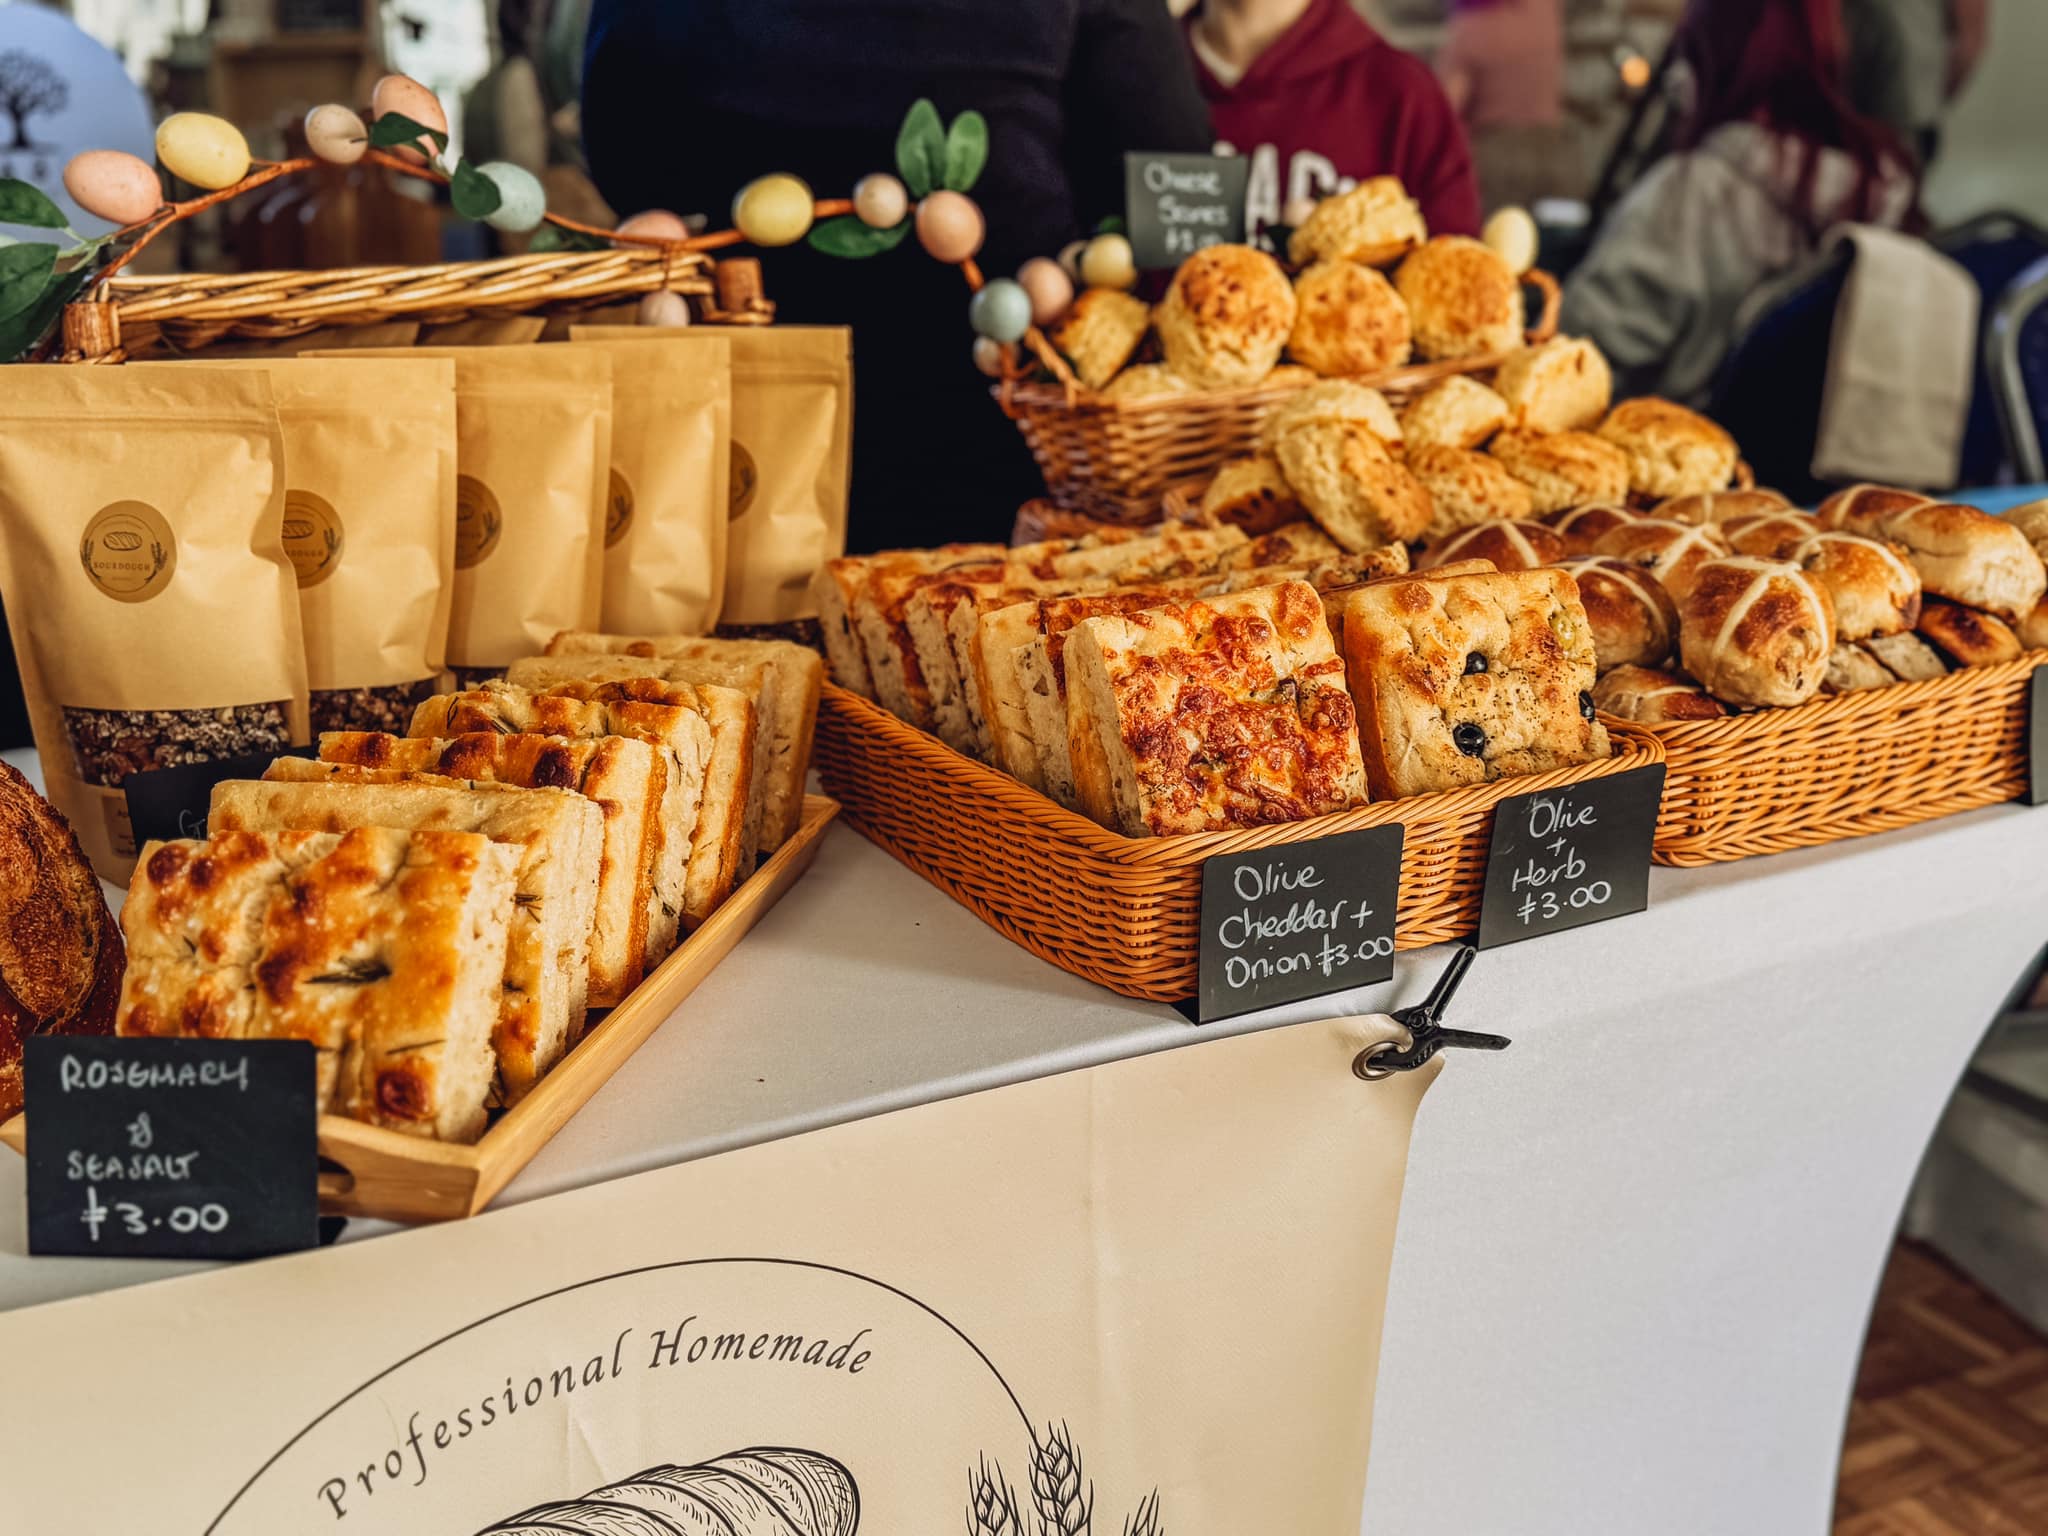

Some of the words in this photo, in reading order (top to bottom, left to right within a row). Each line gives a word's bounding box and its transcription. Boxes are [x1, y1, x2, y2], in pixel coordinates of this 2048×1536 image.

[1529, 797, 1598, 838] Olive
[1546, 836, 1567, 856] +
[1234, 862, 1325, 901] Olive
[1511, 847, 1586, 892] Herb
[1218, 899, 1347, 949] Cheddar
[1350, 900, 1374, 928] +
[1516, 880, 1612, 925] £3.00
[1225, 945, 1311, 988] Onion
[1315, 933, 1395, 977] £3.00
[60, 1054, 249, 1093] ROSEMARY
[80, 1186, 229, 1241] £3.00
[317, 1327, 633, 1520] Professional
[648, 1315, 872, 1375] Homemade
